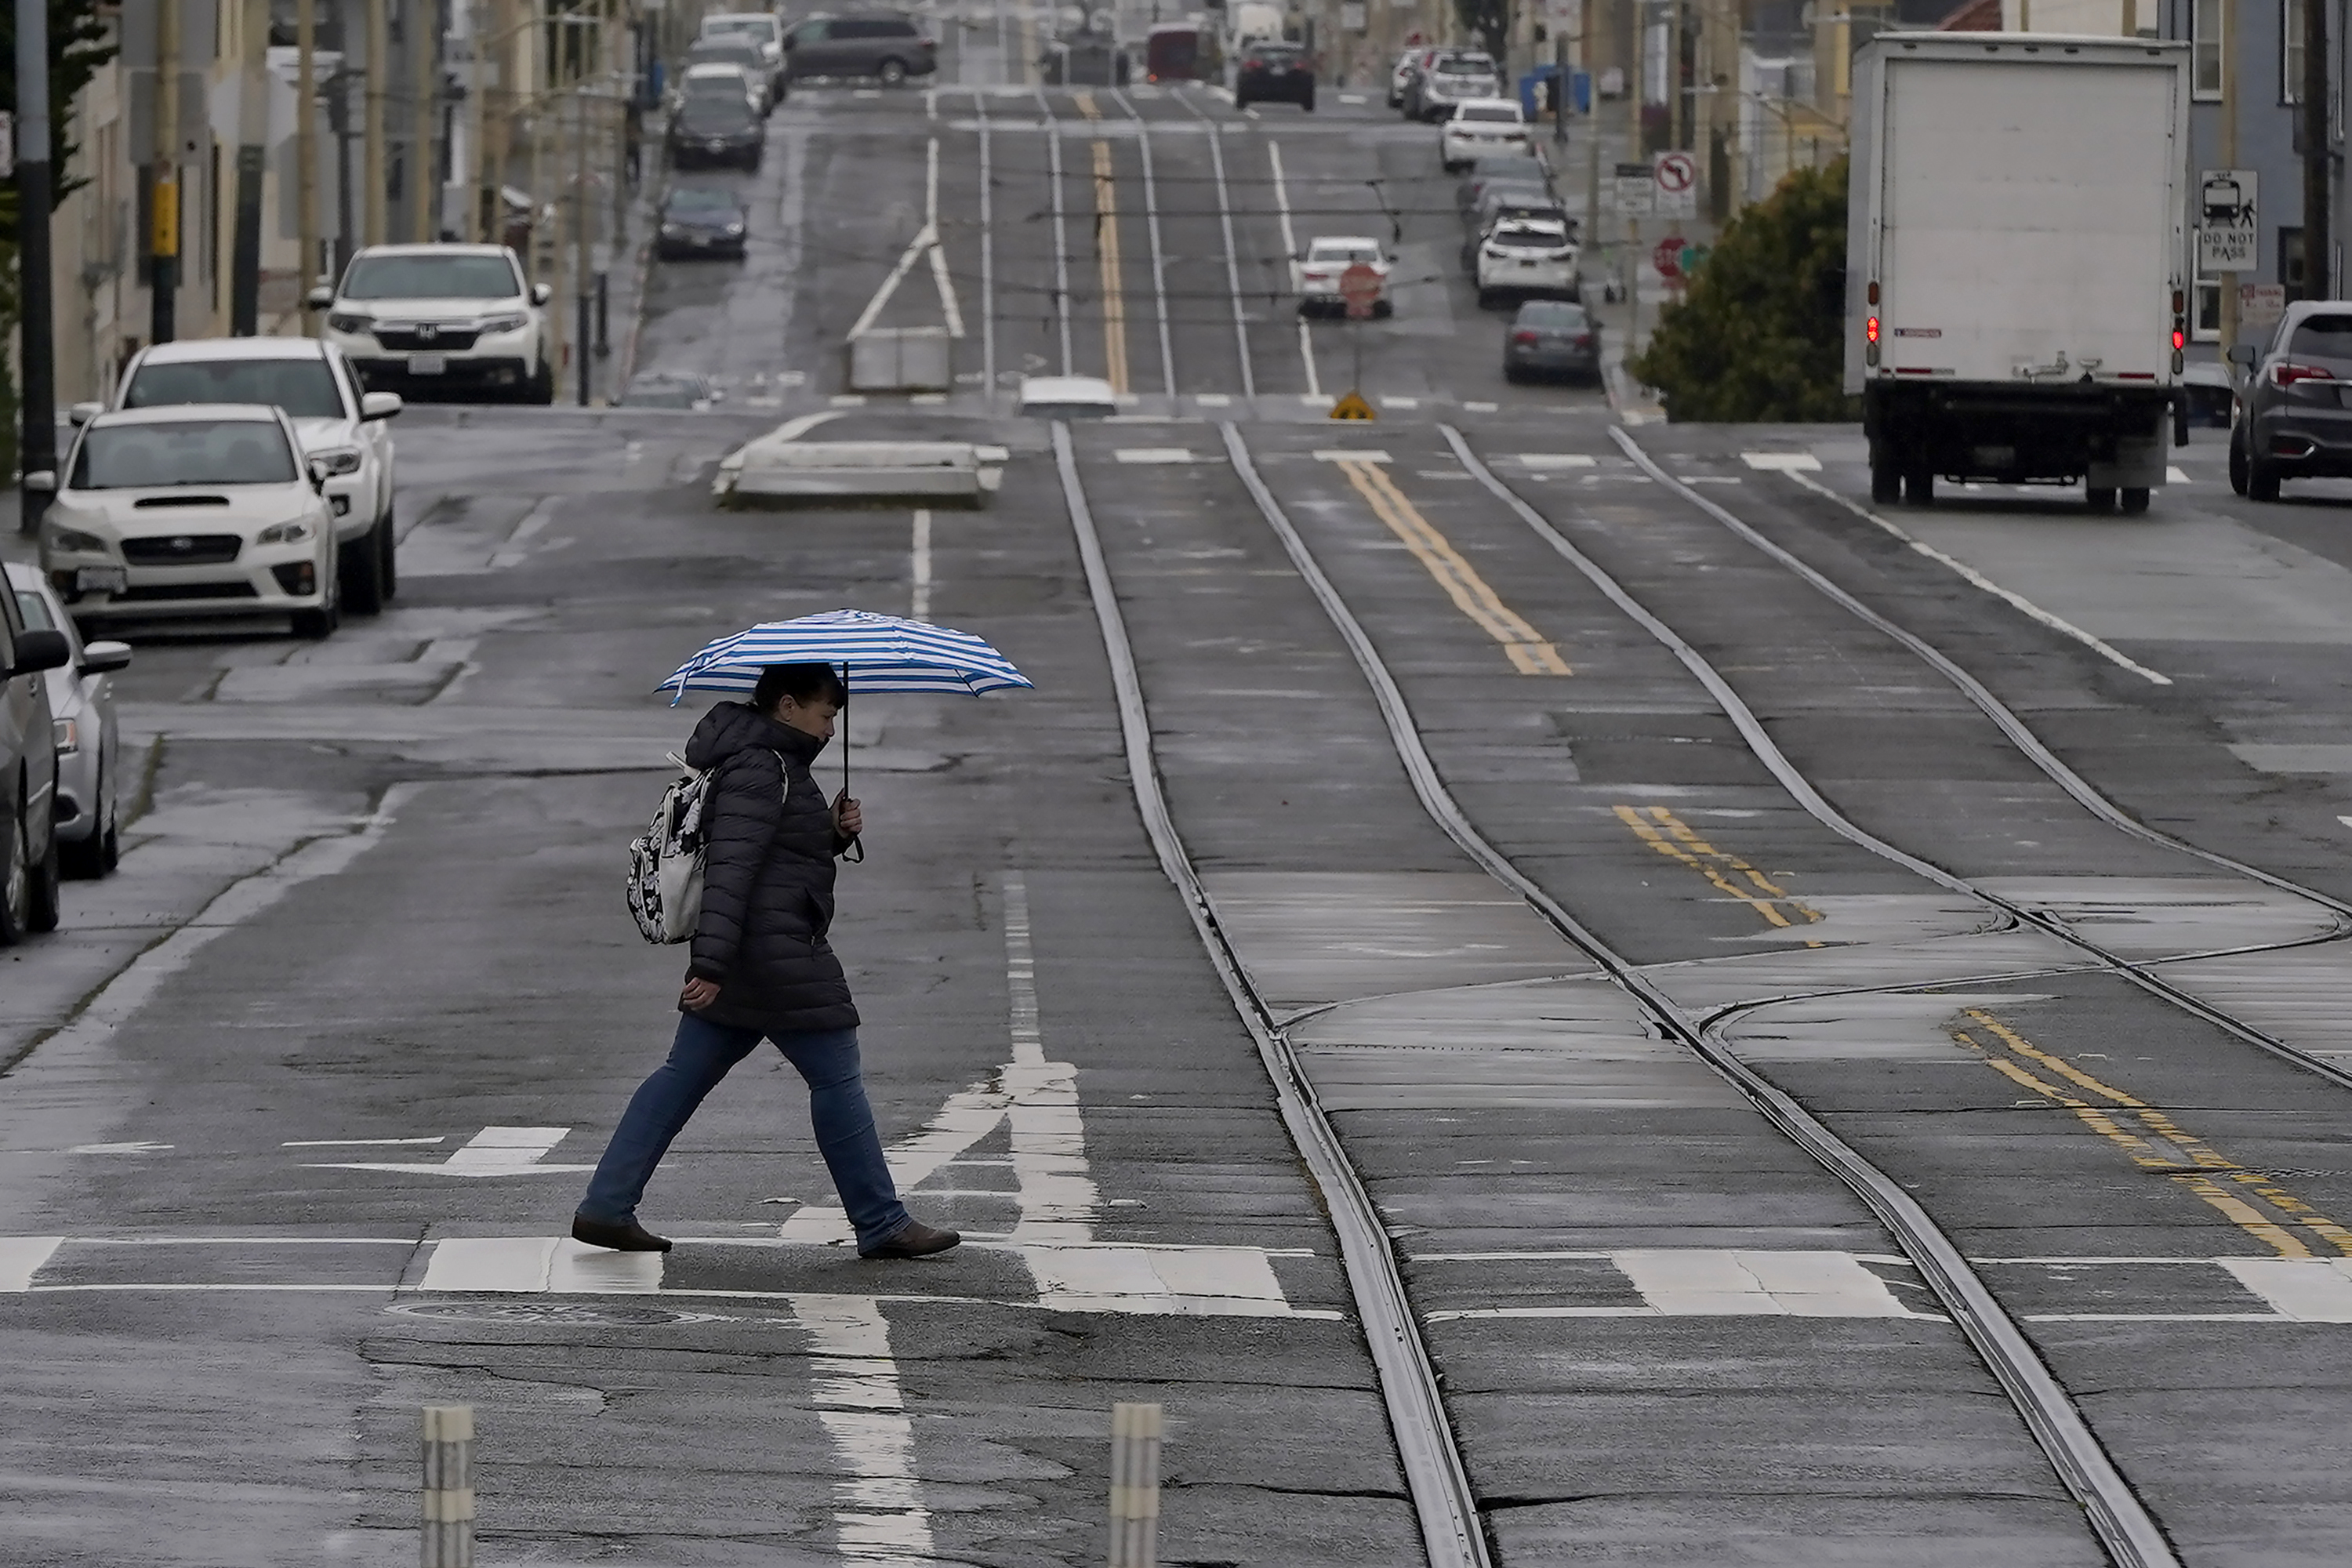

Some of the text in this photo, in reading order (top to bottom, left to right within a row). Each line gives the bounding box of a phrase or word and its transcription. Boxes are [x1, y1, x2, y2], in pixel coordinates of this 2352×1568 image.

[2204, 233, 2255, 245] DO NOT
[2212, 246, 2246, 260] PASS
